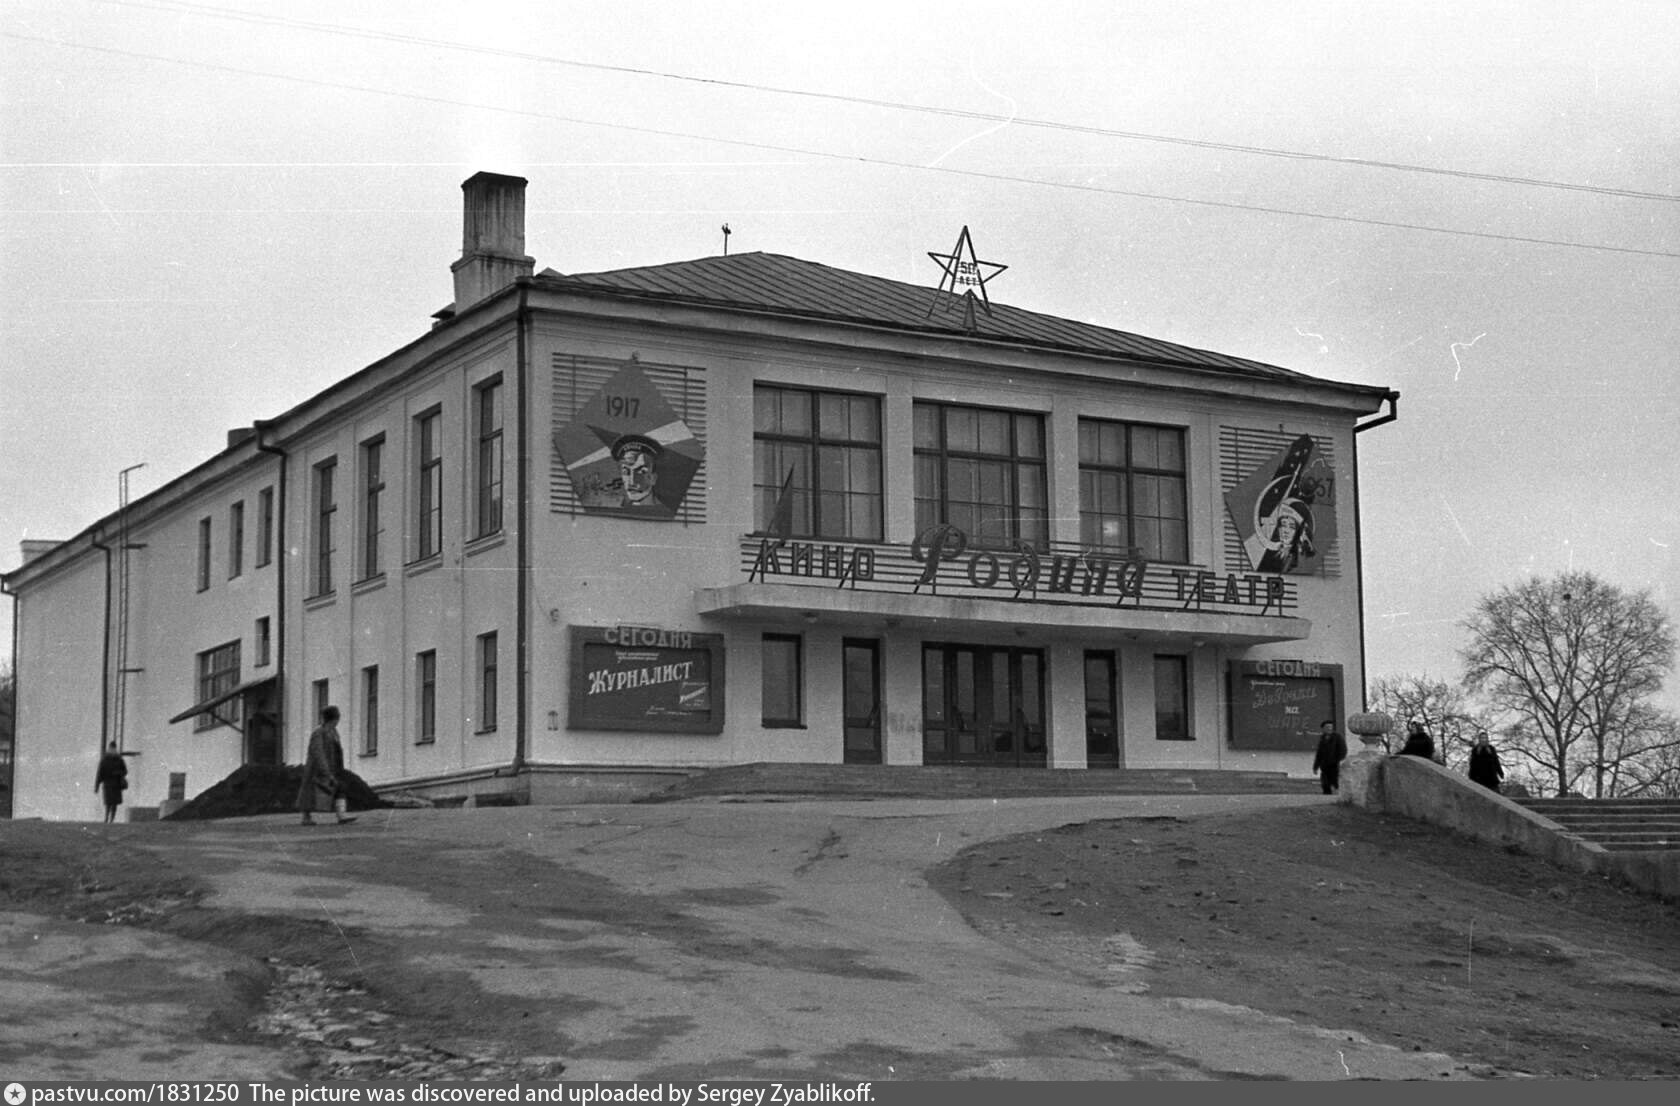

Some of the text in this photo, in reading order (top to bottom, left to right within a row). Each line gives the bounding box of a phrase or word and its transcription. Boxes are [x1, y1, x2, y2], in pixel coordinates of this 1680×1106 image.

[960, 261, 977, 275] 50
[606, 396, 640, 419] 1917
[761, 523, 1286, 607] КИНО Родина ТЕАТР
[603, 627, 693, 649] СЕГОДНЯ
[588, 661, 694, 696] ЖУРНАЛИСТ
[1255, 661, 1321, 677] СЕГОДНЯ
